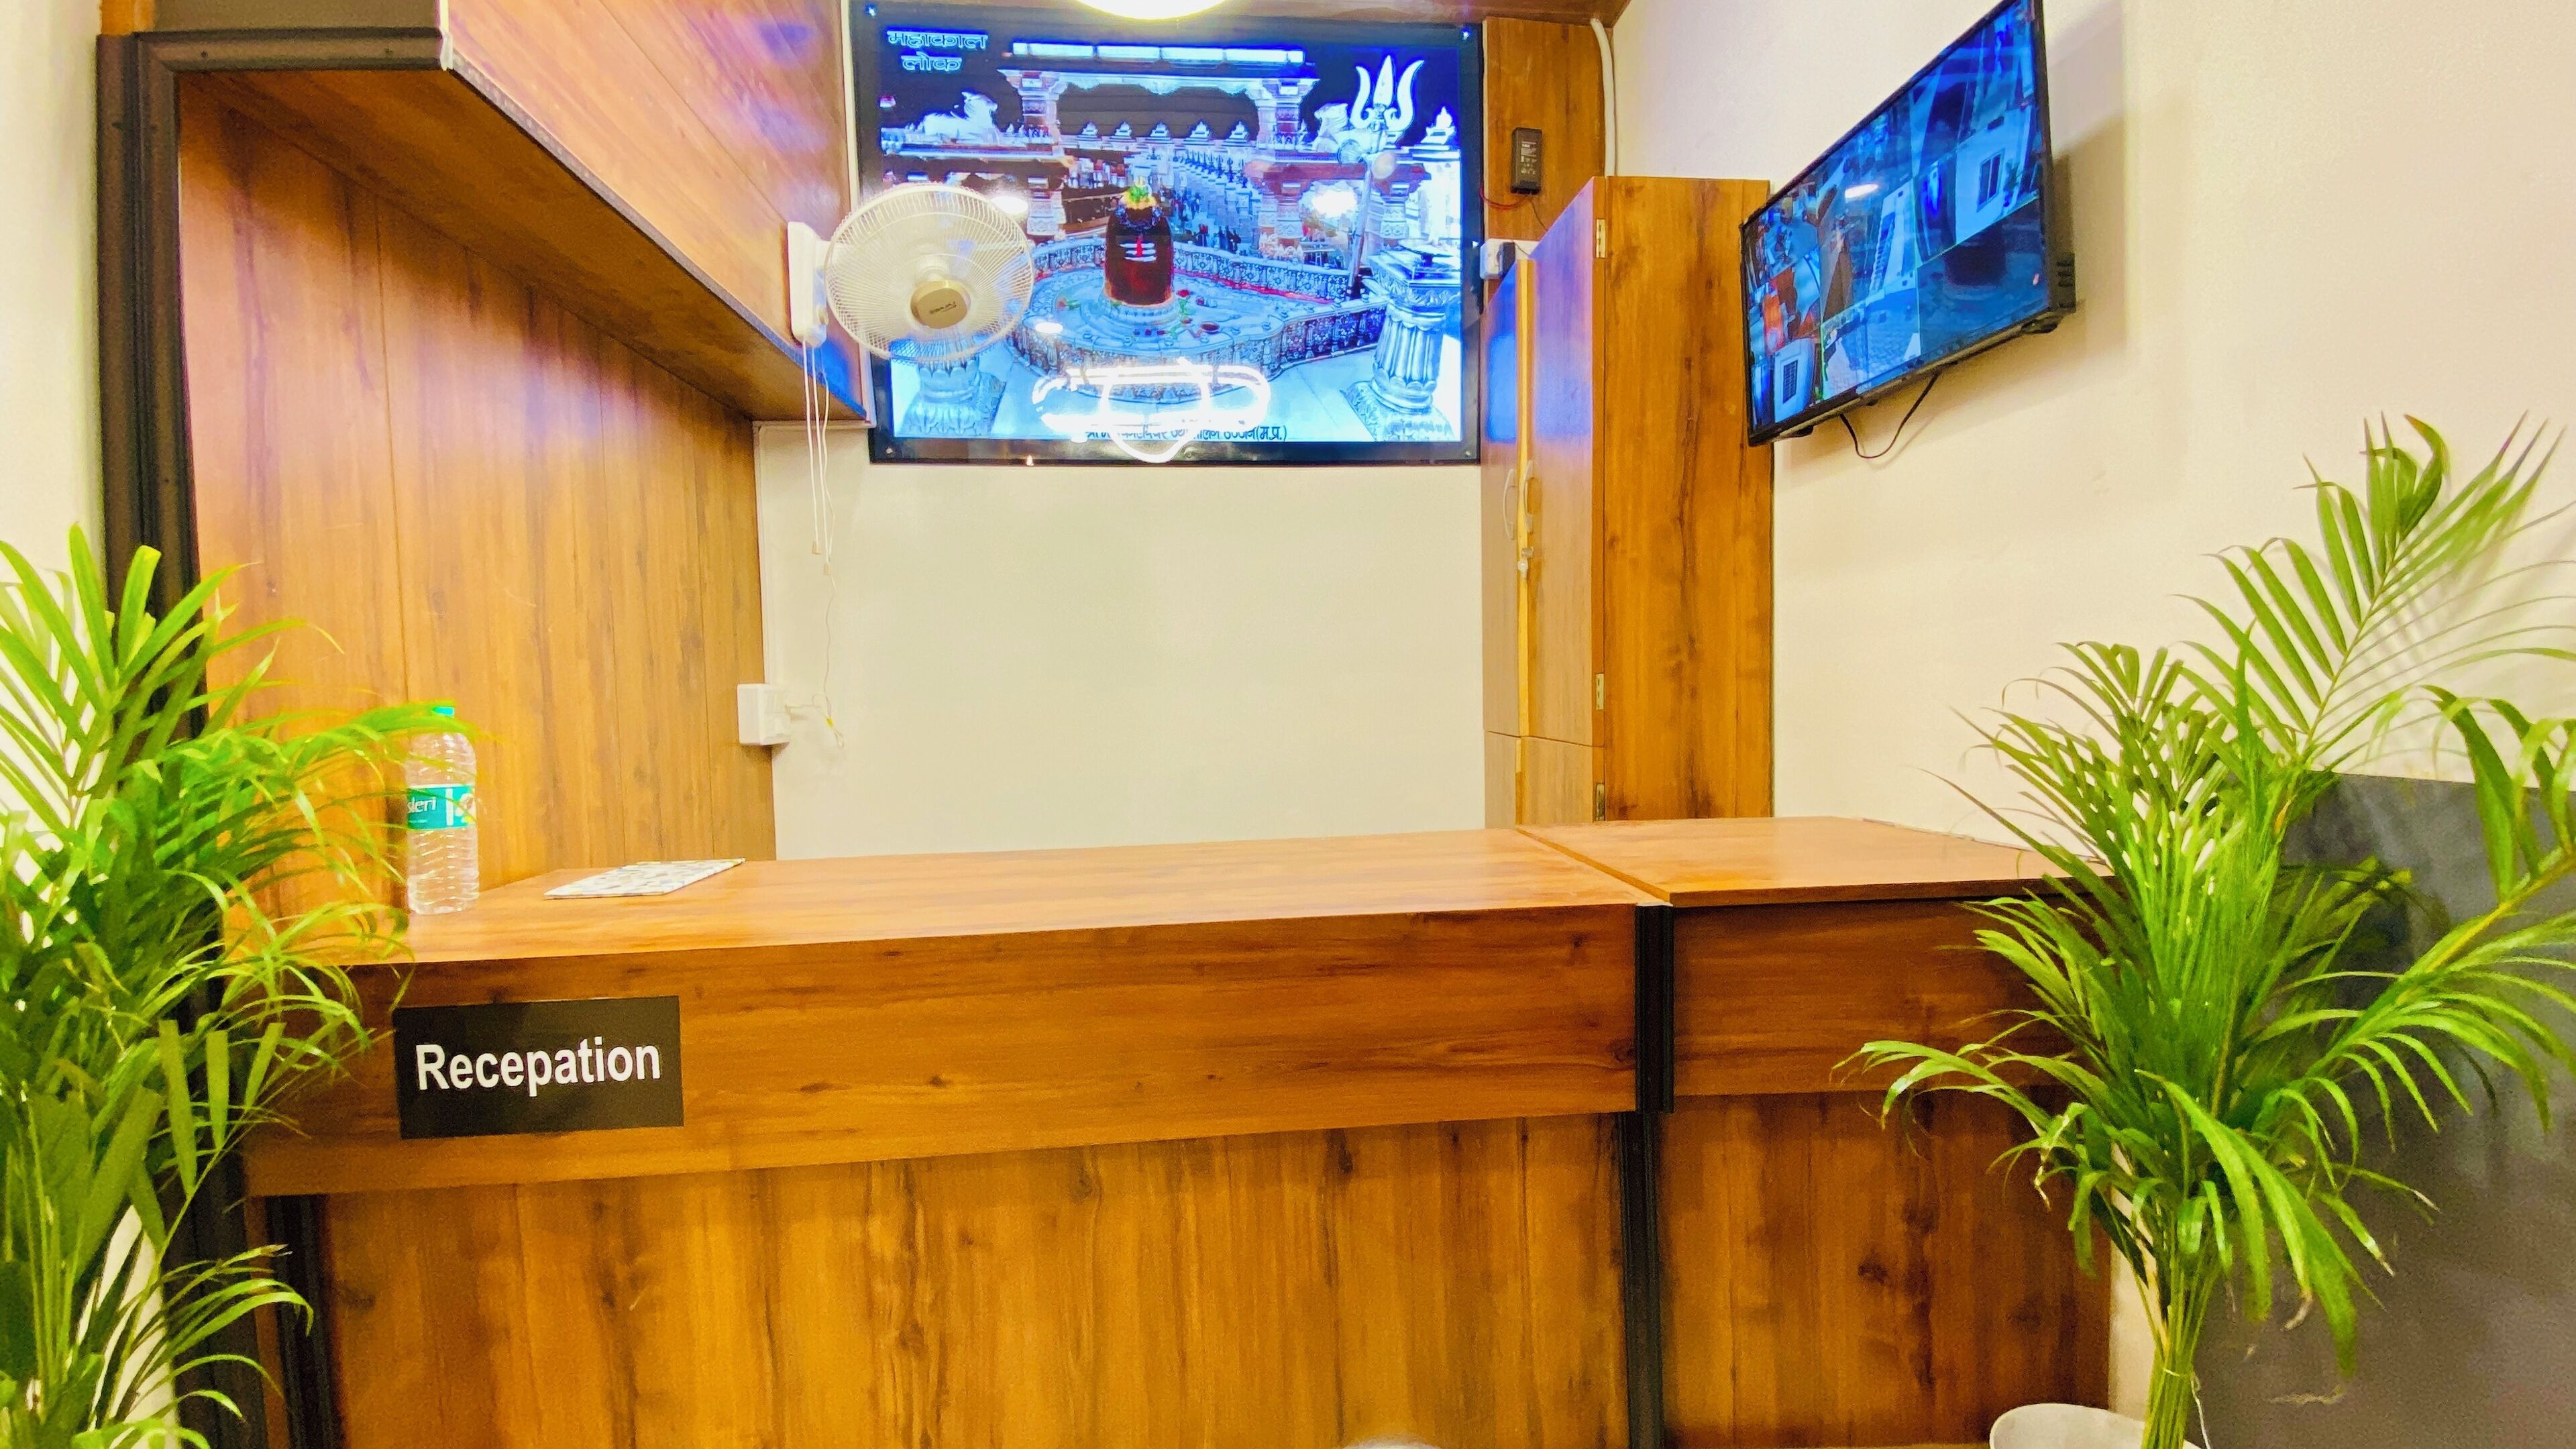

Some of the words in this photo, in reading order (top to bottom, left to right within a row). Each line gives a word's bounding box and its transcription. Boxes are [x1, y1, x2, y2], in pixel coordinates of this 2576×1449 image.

[886, 30, 989, 50] महाकाल
[900, 50, 963, 72] लोक
[415, 1036, 661, 1097] Recepation
